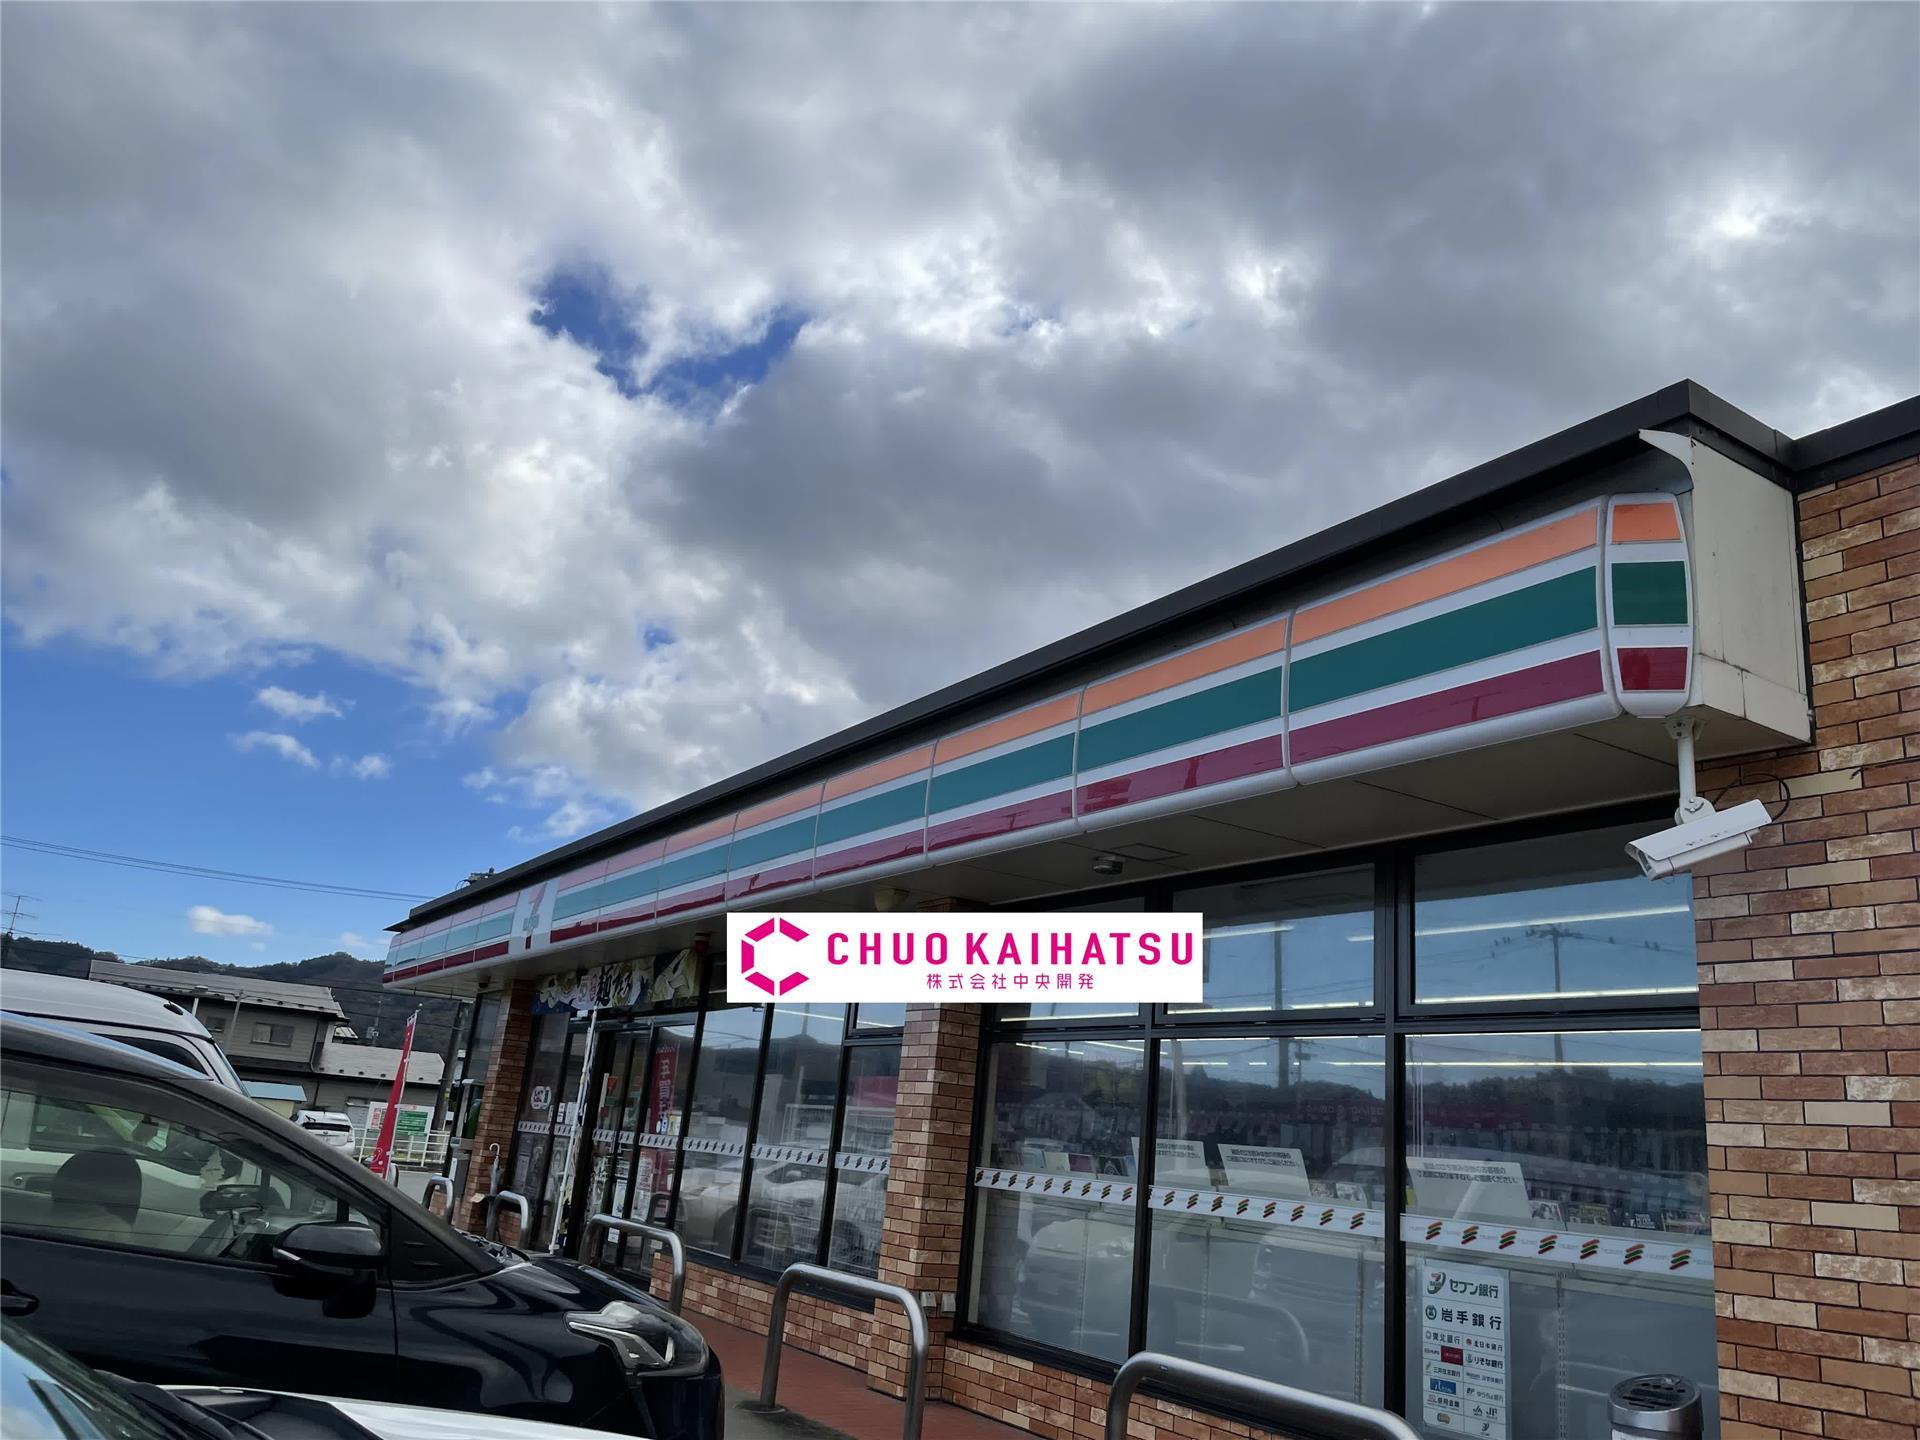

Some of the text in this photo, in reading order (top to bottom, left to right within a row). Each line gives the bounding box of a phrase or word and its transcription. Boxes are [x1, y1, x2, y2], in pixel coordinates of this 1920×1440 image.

[1449, 1279, 1499, 1298] セブン銀行
[1441, 1308, 1502, 1331] 岩手銀行
[1474, 1356, 1503, 1369] りそな銀行
